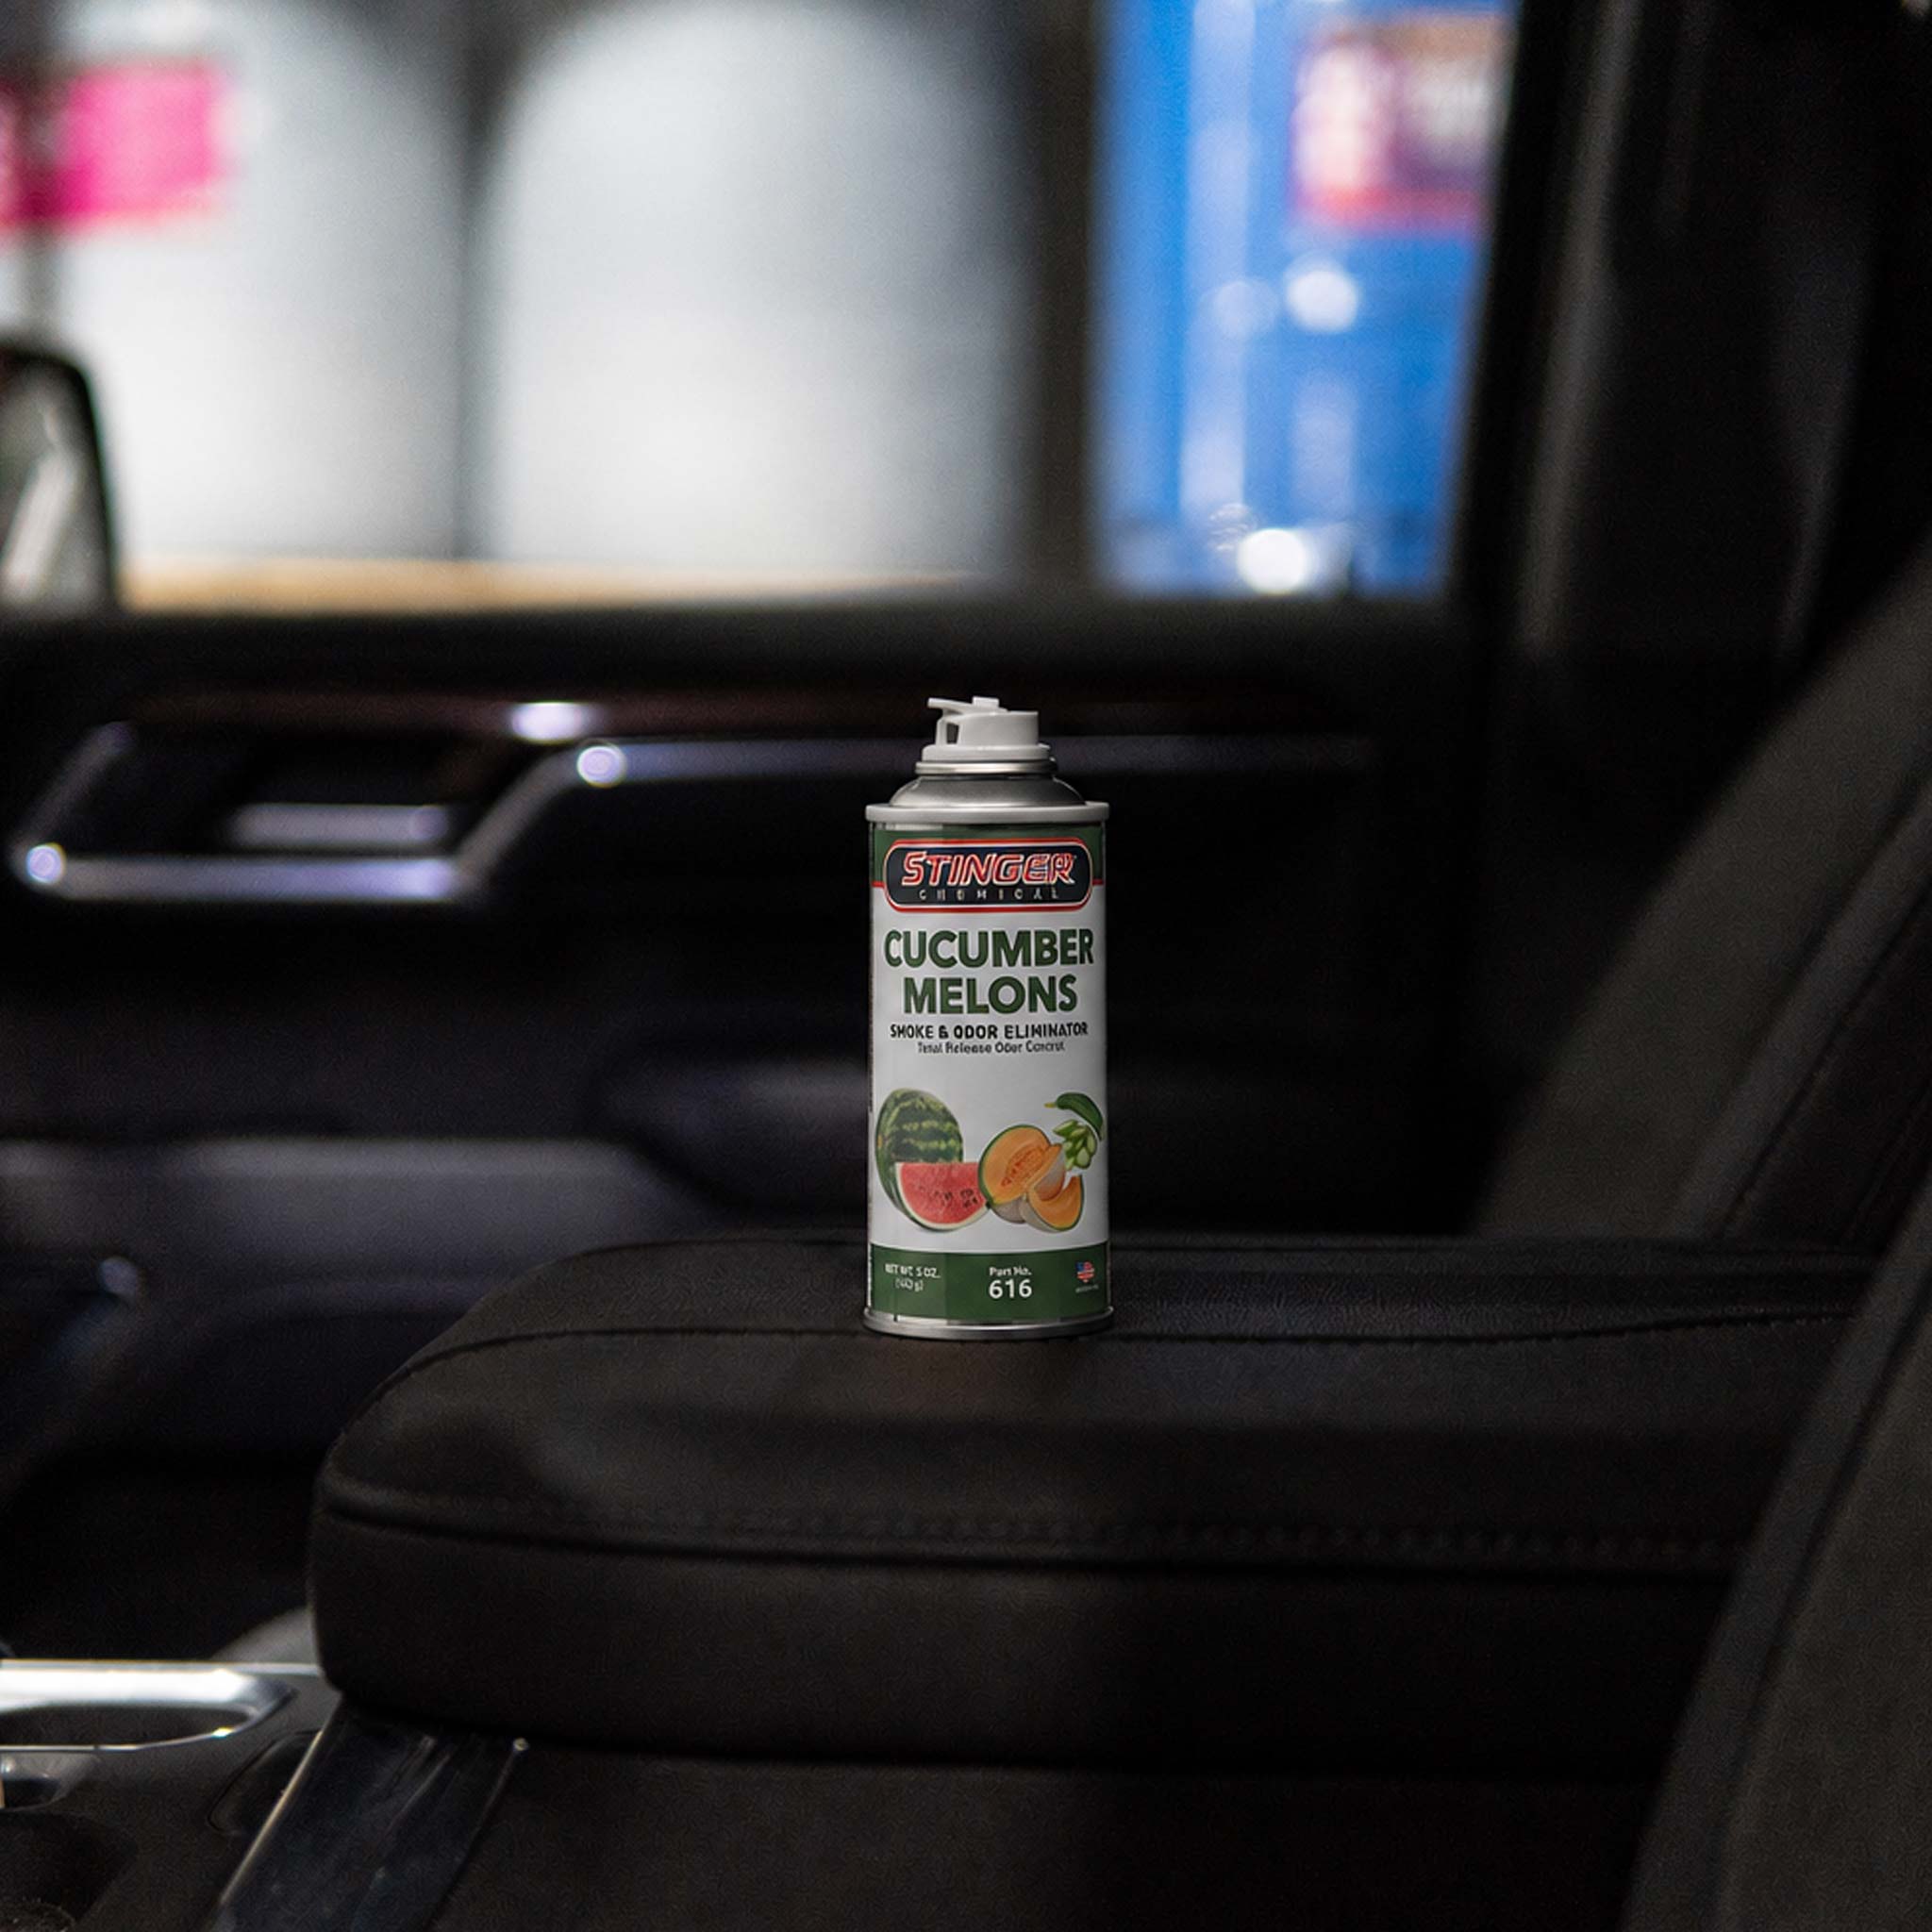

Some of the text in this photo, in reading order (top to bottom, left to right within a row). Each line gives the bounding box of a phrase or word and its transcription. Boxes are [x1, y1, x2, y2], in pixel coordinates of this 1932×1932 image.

[902, 851, 1074, 886] STINGER
[884, 929, 1093, 968] CUCUMBER
[904, 974, 1077, 1014] MELONS
[891, 1022, 1089, 1040] SMOKE & ODOR ELIMINATOR
[989, 1279, 1032, 1298] 616
